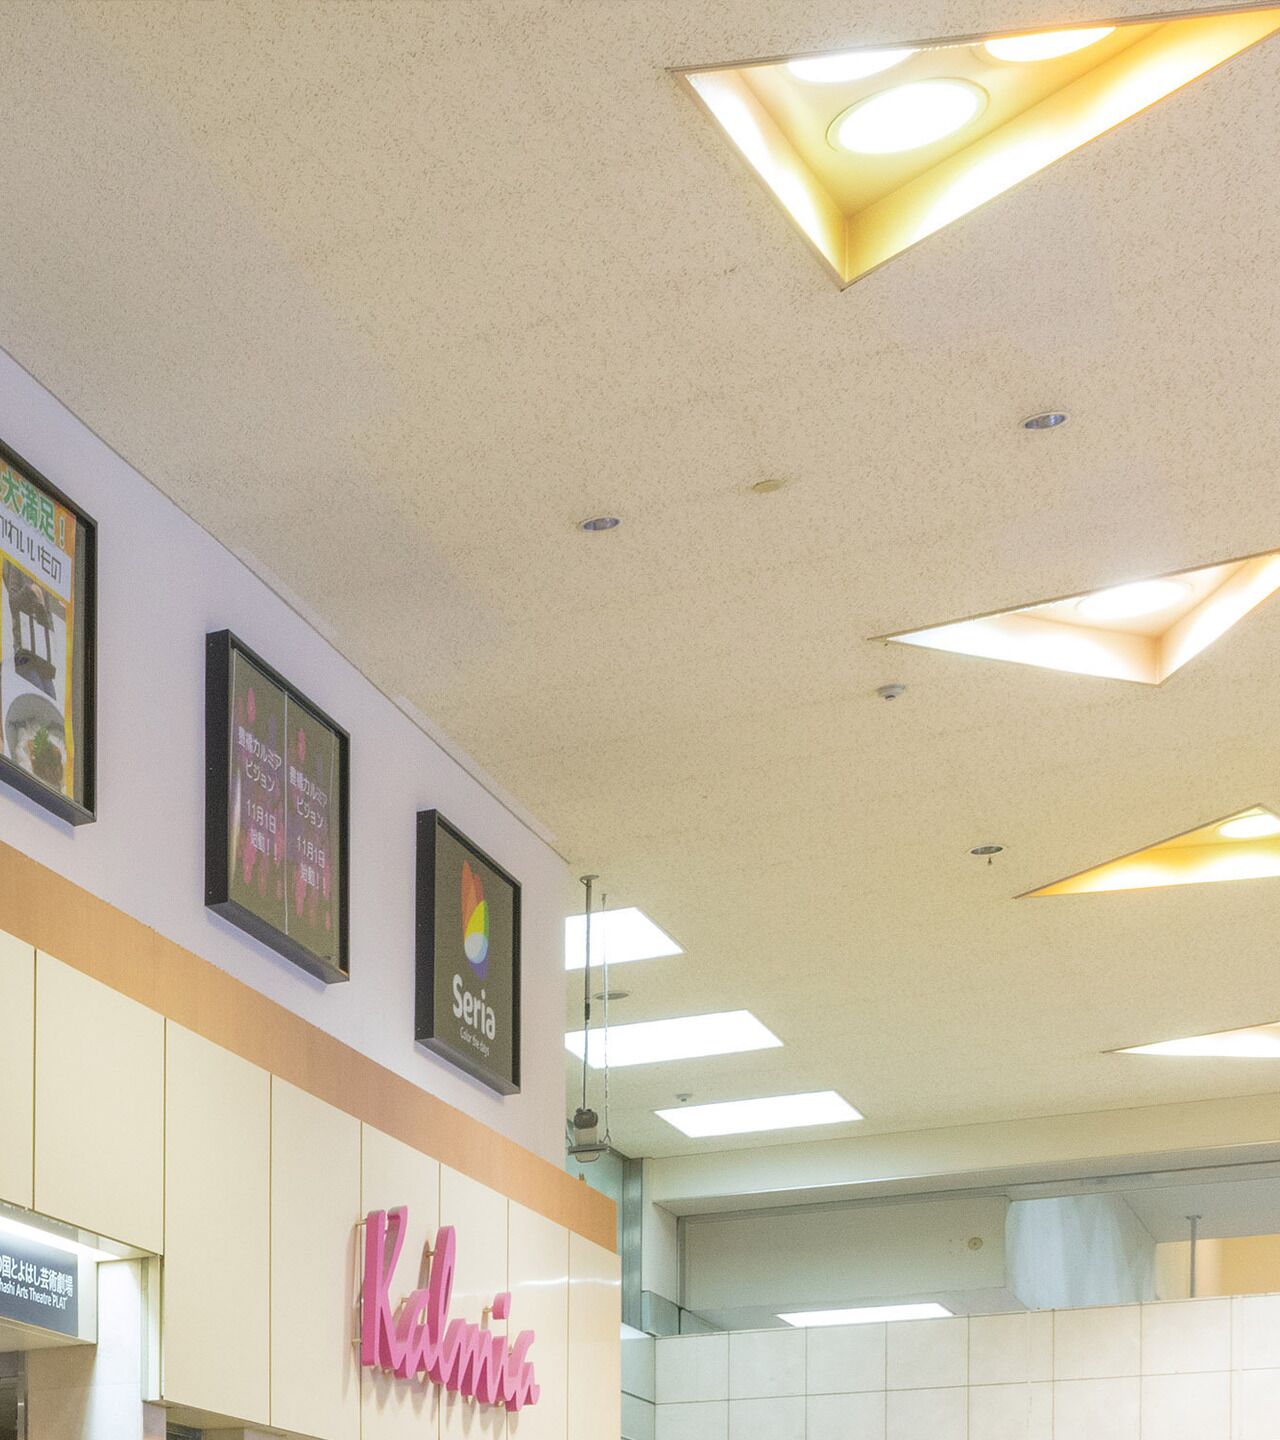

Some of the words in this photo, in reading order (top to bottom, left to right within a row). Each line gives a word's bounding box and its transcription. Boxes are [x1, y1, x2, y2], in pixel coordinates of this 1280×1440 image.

[452, 973, 496, 1041] Seria
[16, 1284, 29, 1299] Arts
[29, 1286, 52, 1306] Theatre
[52, 1293, 68, 1310] PLAT
[362, 1205, 542, 1413] Kalmia
